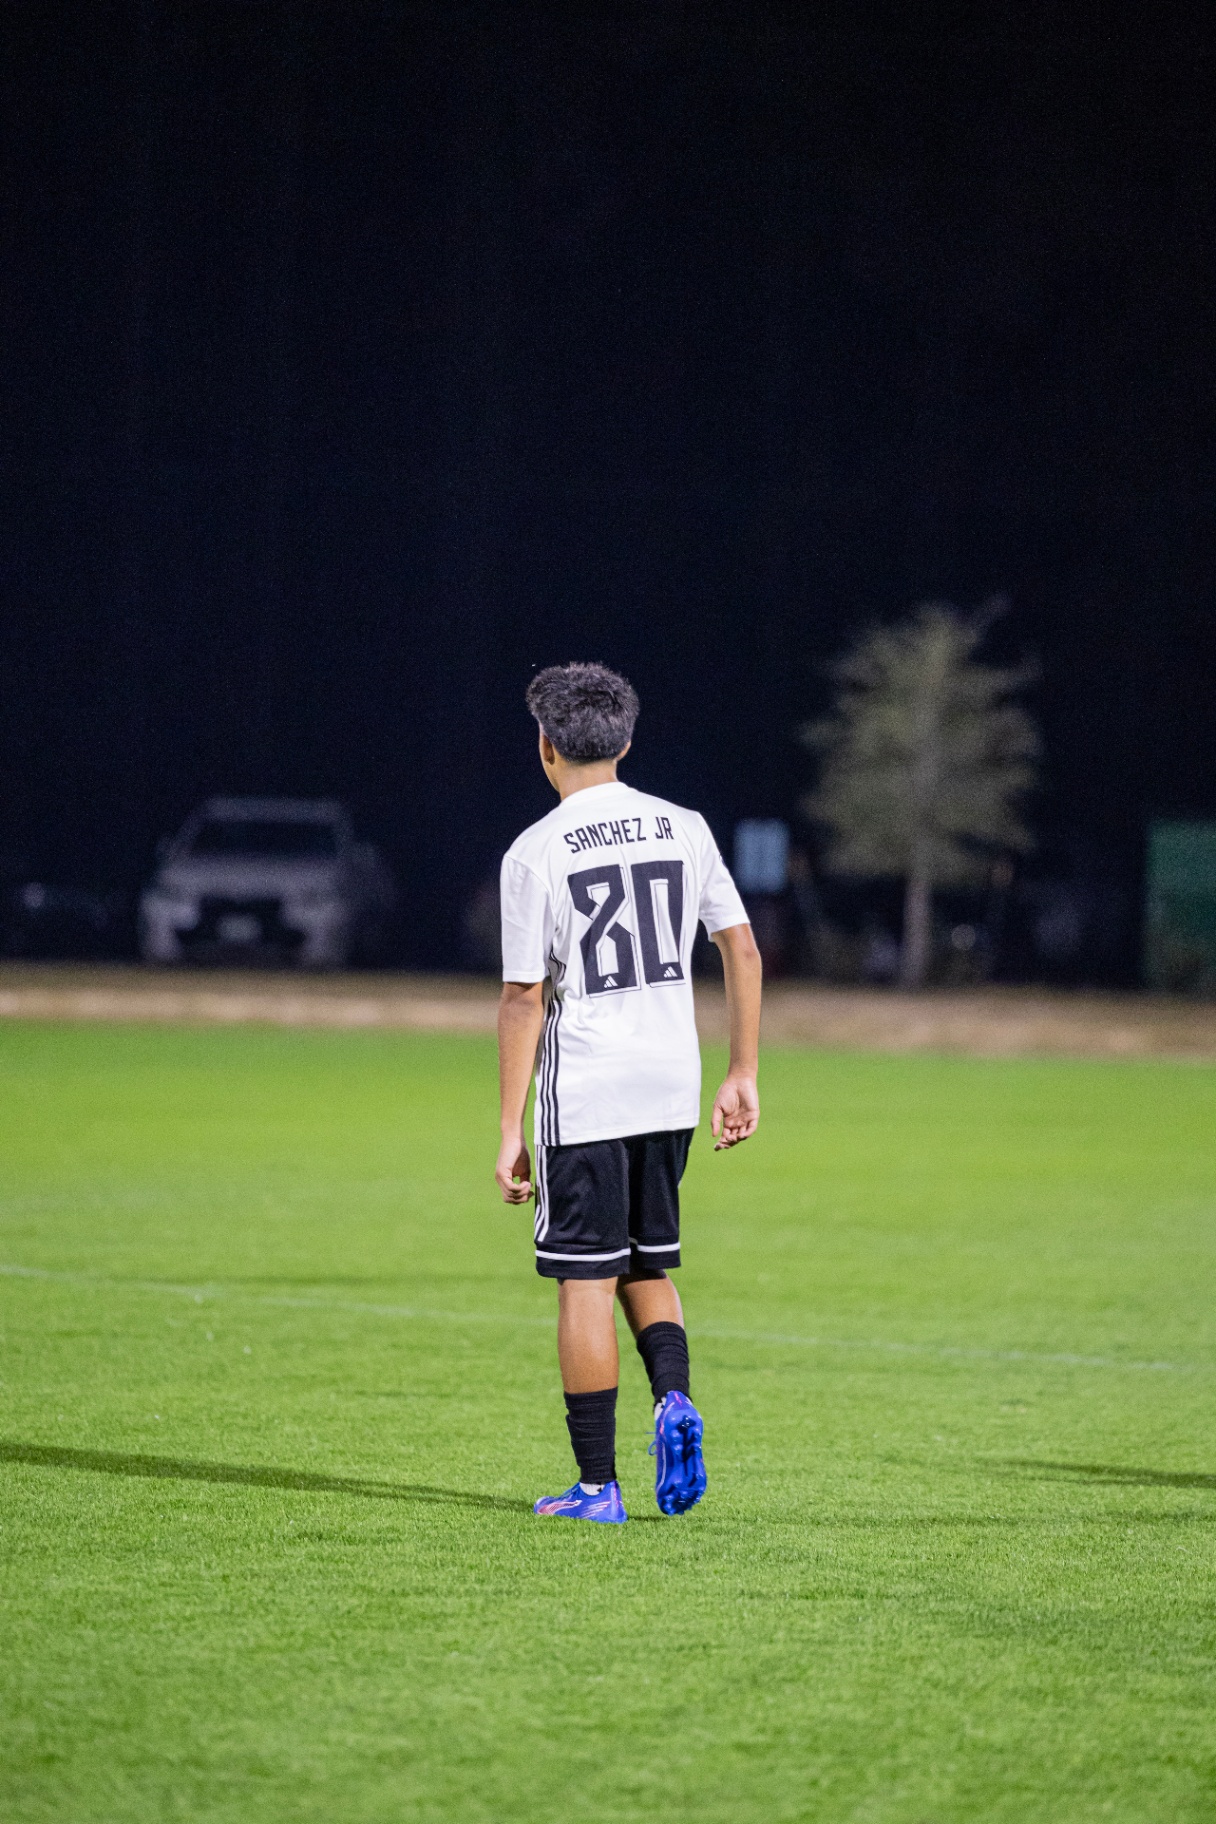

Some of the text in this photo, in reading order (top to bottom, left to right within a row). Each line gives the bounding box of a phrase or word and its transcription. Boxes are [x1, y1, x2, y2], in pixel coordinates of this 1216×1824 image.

[563, 816, 675, 854] SANCHEZ JR
[567, 860, 686, 998] 80
